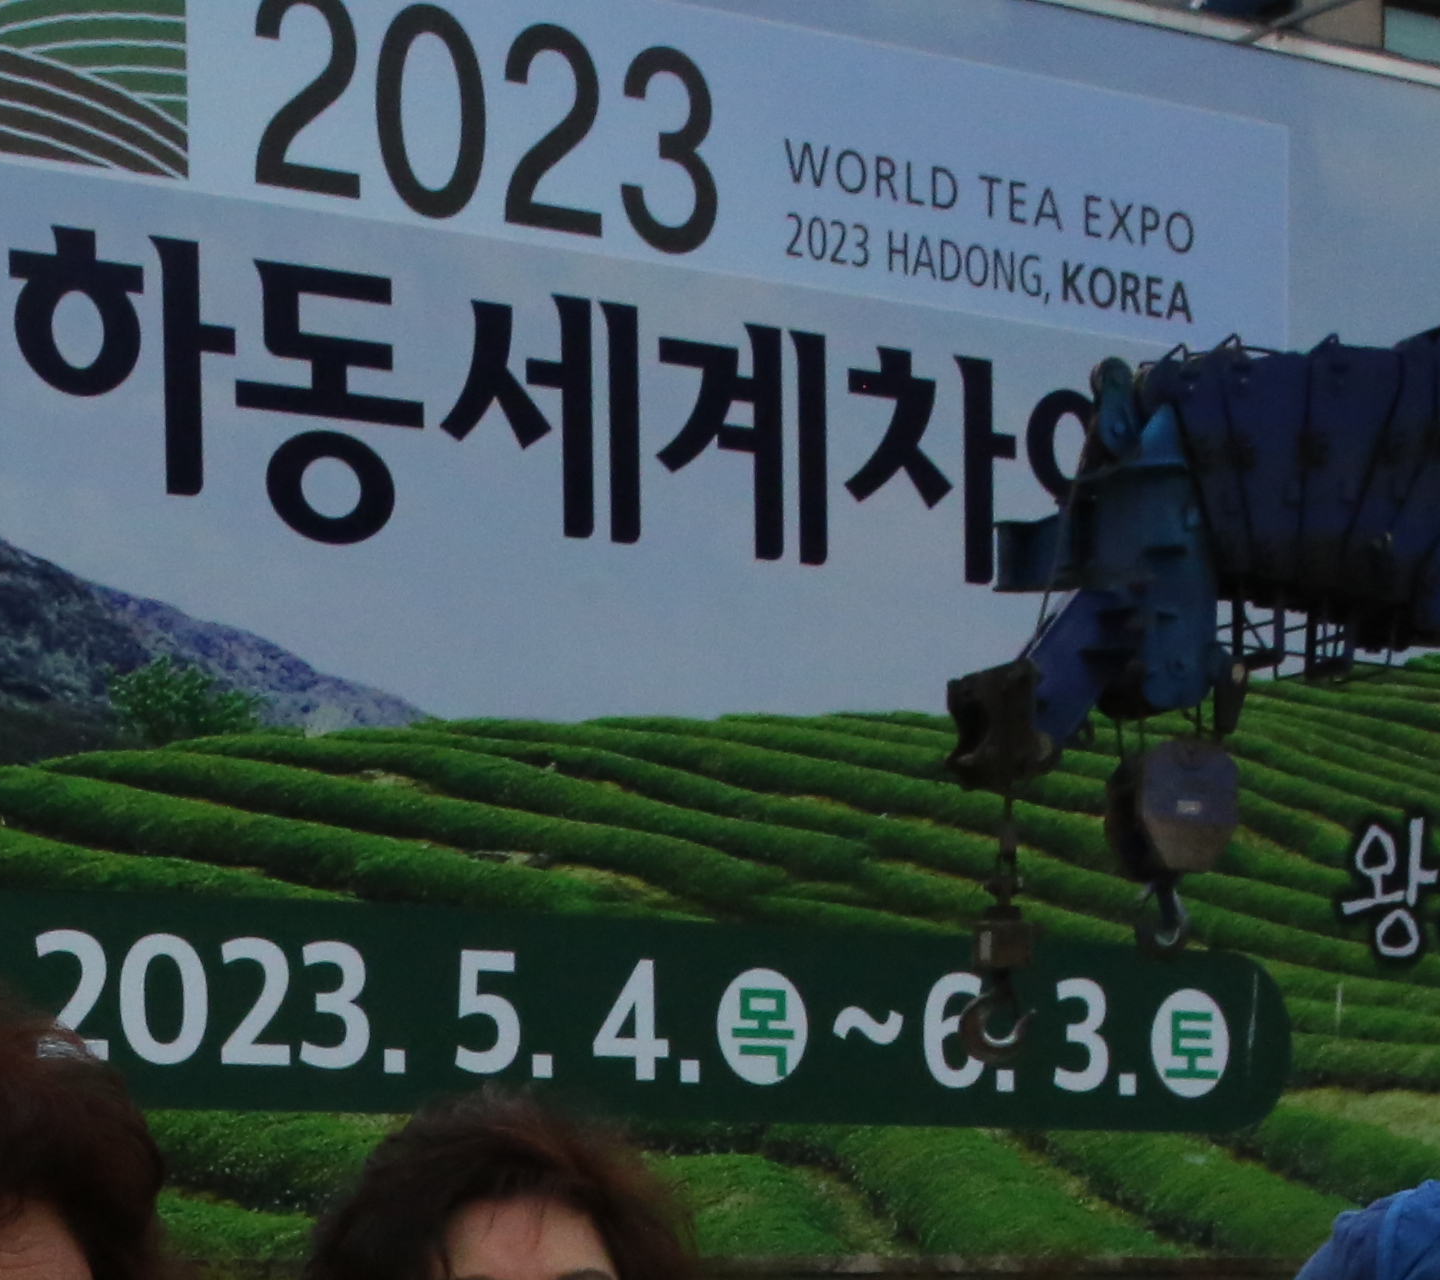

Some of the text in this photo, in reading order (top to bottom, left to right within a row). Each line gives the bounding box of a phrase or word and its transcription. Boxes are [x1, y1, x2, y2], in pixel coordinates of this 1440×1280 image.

[253, 0, 719, 254] 2023
[783, 138, 1195, 255] WORLD TEA EXPO
[784, 212, 1194, 324] 2023 HADONG, KOREA
[34, 928, 407, 1075] 2023.
[453, 948, 554, 1079] 5.
